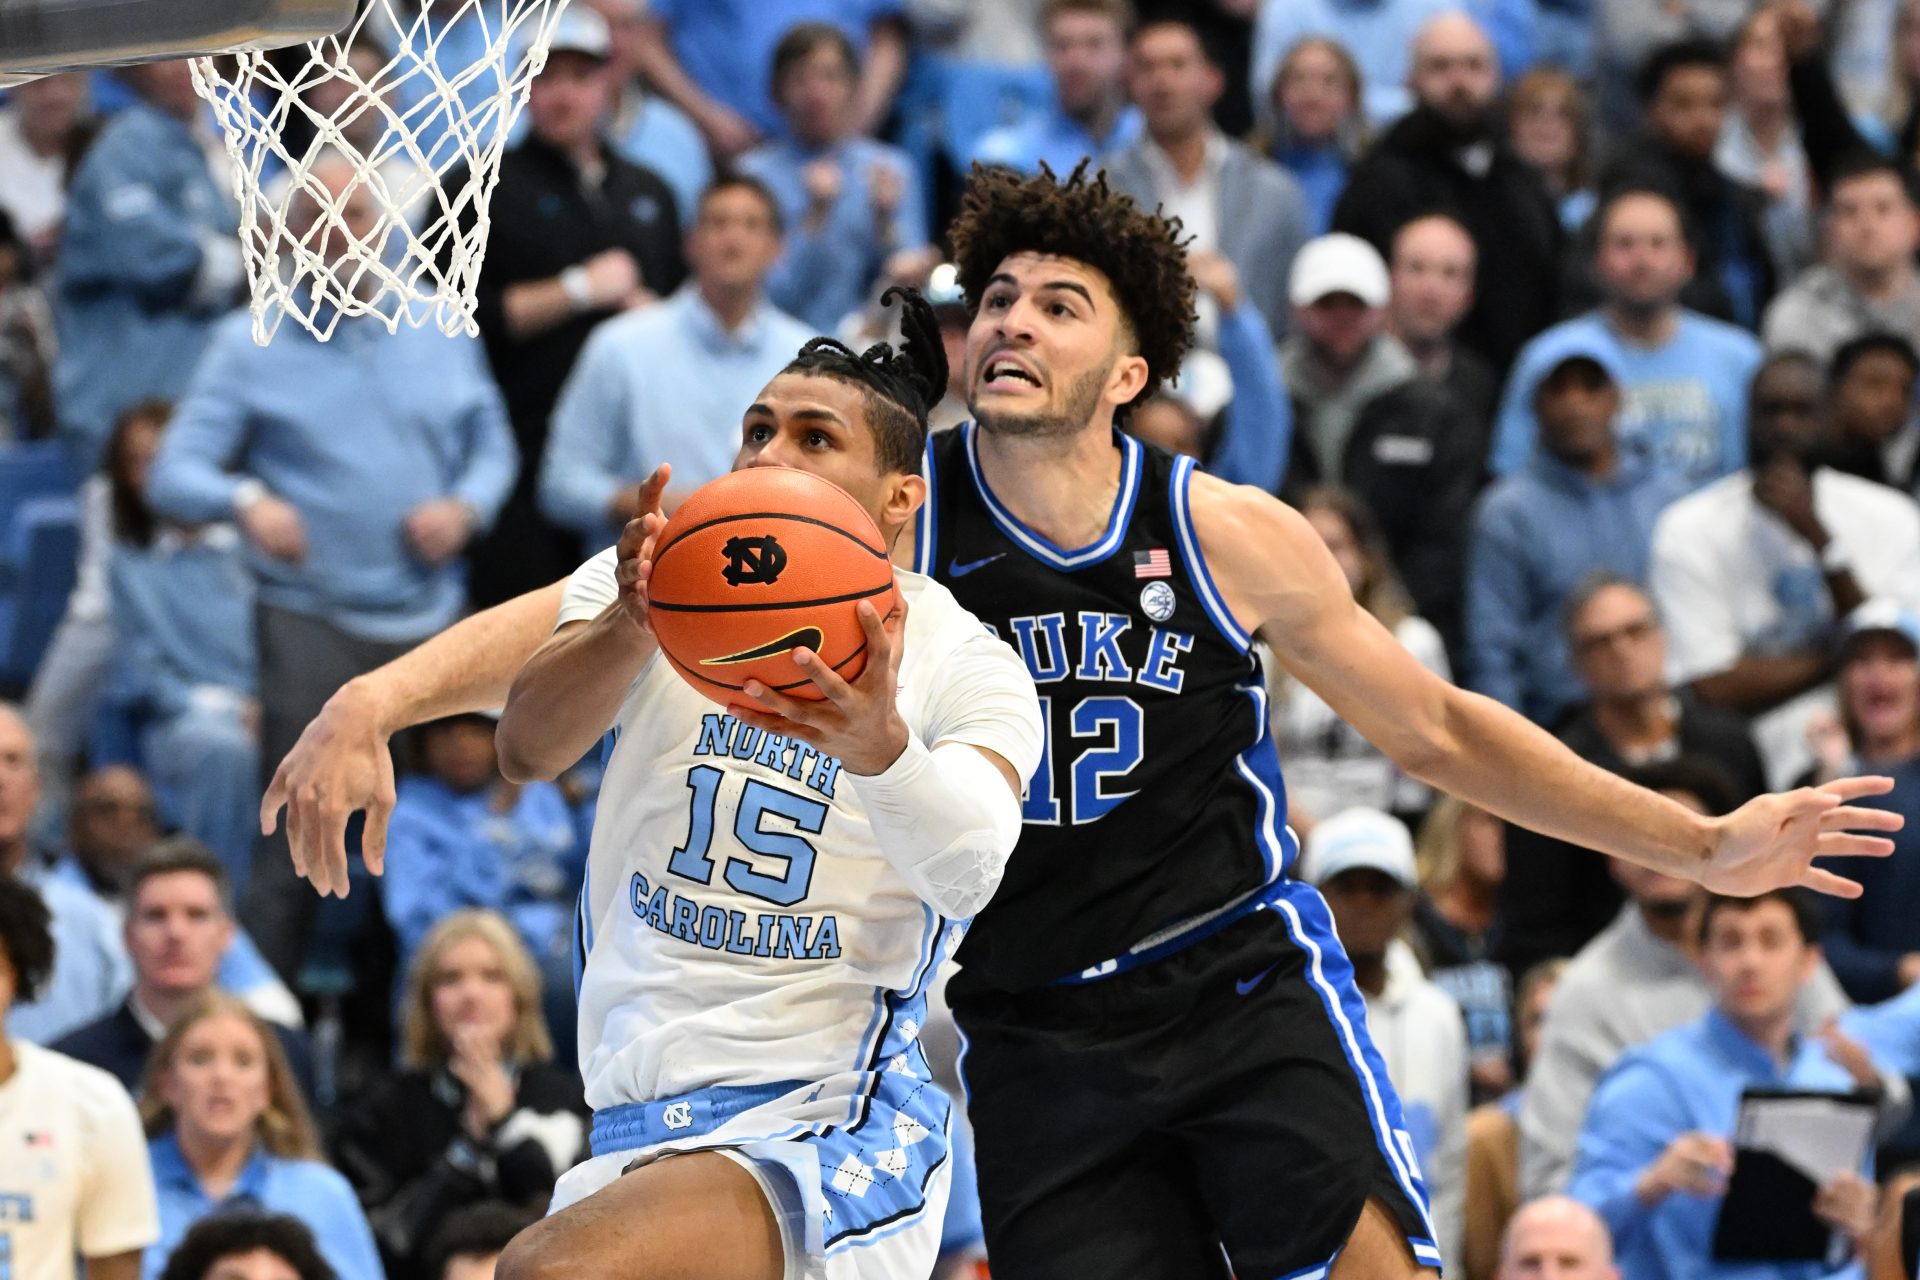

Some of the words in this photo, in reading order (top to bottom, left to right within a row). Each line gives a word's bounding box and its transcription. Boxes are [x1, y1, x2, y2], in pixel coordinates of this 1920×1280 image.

[982, 611, 1195, 694] UKE
[667, 763, 830, 908] 15
[629, 871, 842, 960] CAROLINA
